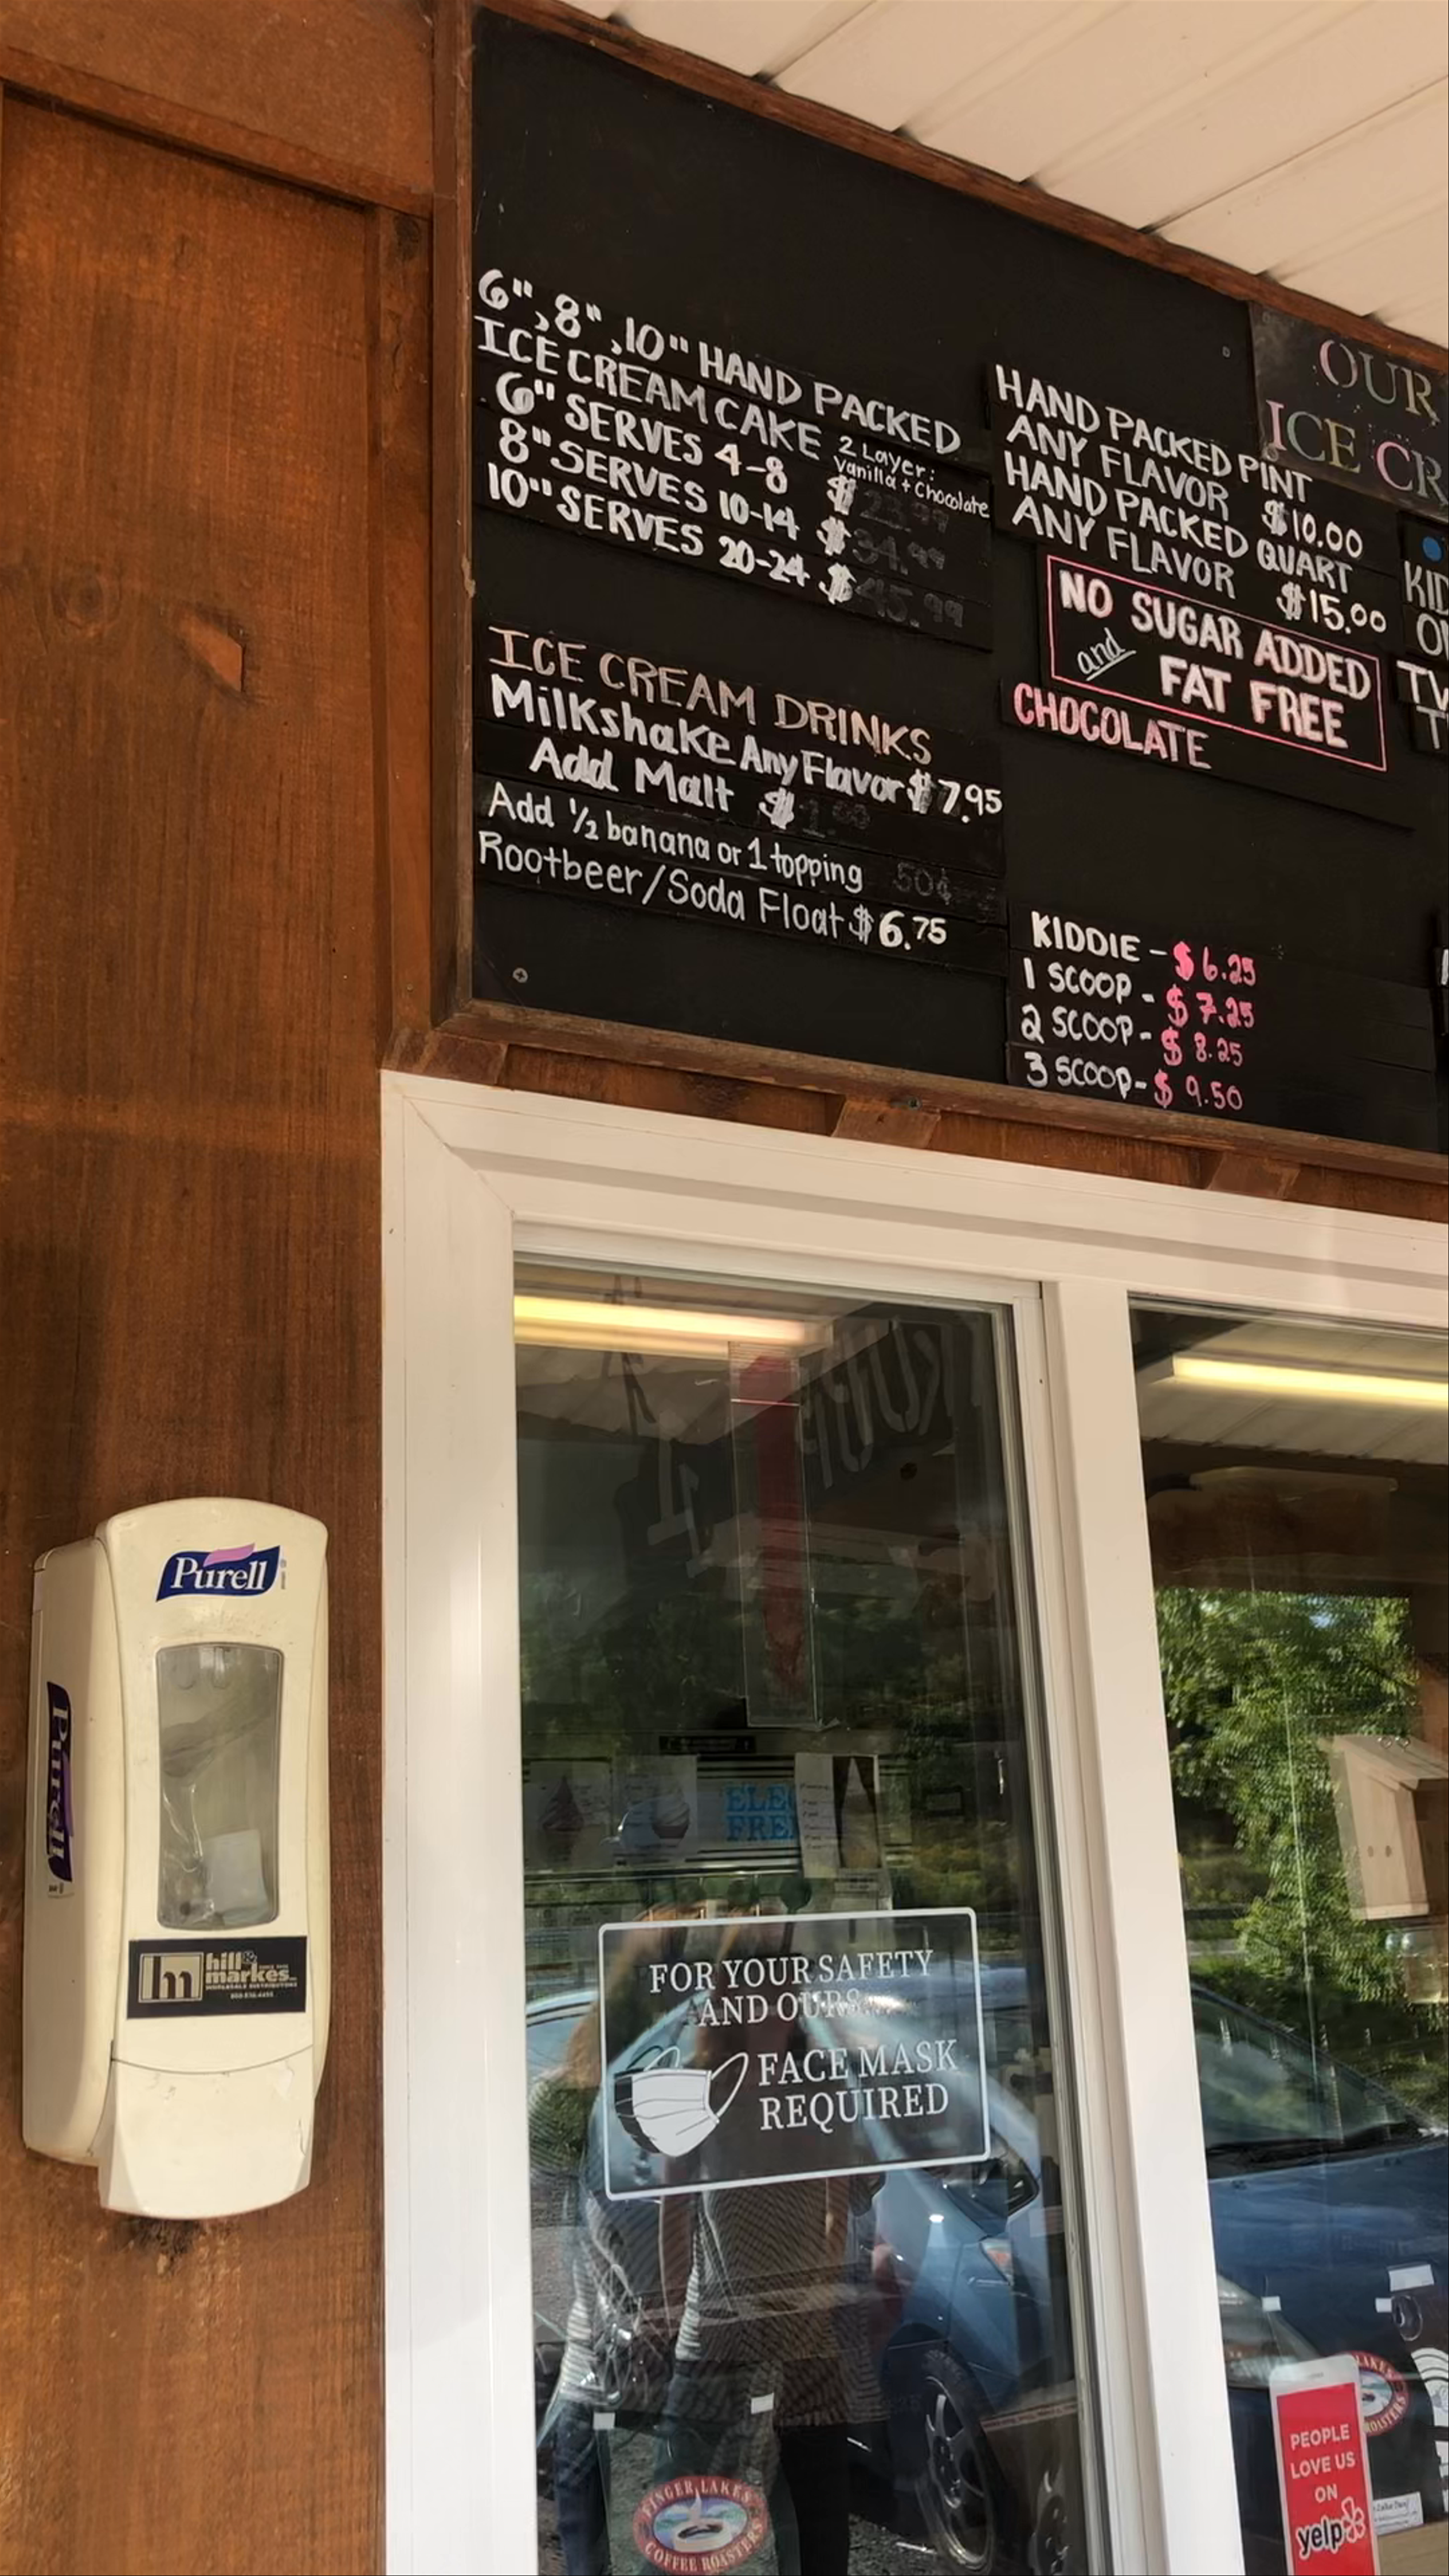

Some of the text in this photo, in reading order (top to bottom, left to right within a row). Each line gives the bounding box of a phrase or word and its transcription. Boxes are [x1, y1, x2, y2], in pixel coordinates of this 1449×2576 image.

[475, 315, 821, 460] ICE CREAM CAKE
[699, 341, 802, 406] HAND
[814, 382, 961, 454] PACKED
[1320, 340, 1441, 423] OUR
[496, 371, 788, 494] 6" SERVES 4-8
[838, 436, 935, 481] 2 Layer:
[996, 364, 1313, 503] HAND PACKED PINT
[1266, 400, 1360, 474] ICE
[499, 418, 551, 463] 8"
[550, 440, 708, 513] SERVES
[719, 490, 800, 540] 10-14
[915, 481, 990, 518] Chocolate
[1006, 415, 1363, 558] ANY FLAVOR $10.00
[488, 462, 552, 508] 10"
[557, 485, 703, 556] SERVES
[718, 535, 811, 587] 20-24
[1004, 450, 1353, 594] HAND PACKED QUART
[1012, 495, 1386, 634] ANY FLAVOR $15.00
[1059, 569, 1371, 700] NO SUGAR ADDED
[489, 626, 932, 764] ICE CREAM DRINKS
[1077, 628, 1349, 749] and FAT FREE
[491, 674, 1003, 823] Milkshake Any Flavor $7.95
[1013, 683, 1211, 769] CHOCOLATE
[529, 737, 619, 792] Add
[635, 757, 734, 812] Malt
[488, 781, 555, 828] Add
[606, 809, 710, 861] banana
[718, 842, 742, 866] or
[748, 837, 768, 871] 1
[770, 842, 863, 894] topping
[759, 887, 844, 939] Float
[849, 904, 946, 950] $6.75
[1023, 958, 1035, 989] 1
[1166, 984, 1254, 1028] $7.25
[1173, 941, 1256, 986] $6.25
[1021, 1004, 1044, 1044] 2
[1161, 1026, 1242, 1066] $8.25
[1024, 1051, 1048, 1087] 3
[1154, 1069, 1243, 1109] $9.50
[171, 1556, 266, 1590] Purell
[50, 1707, 68, 1858] Purell
[726, 1816, 794, 1841] FRE
[206, 1952, 241, 1970] hill
[206, 1963, 289, 1984] markes
[649, 1950, 933, 1993] FOR YOUR SAFETY
[698, 1995, 768, 2027] AND
[758, 2039, 958, 2087] FACE MASK
[760, 2082, 949, 2134] REQUIRED
[1290, 2424, 1350, 2450] PEOPLE
[1291, 2452, 1355, 2479] LOVE US
[643, 2478, 749, 2517] FINGER LAKES
[1315, 2484, 1337, 2503] ON
[645, 2518, 763, 2571] COFFEE ROASTERS
[1297, 2518, 1343, 2556] yelp
